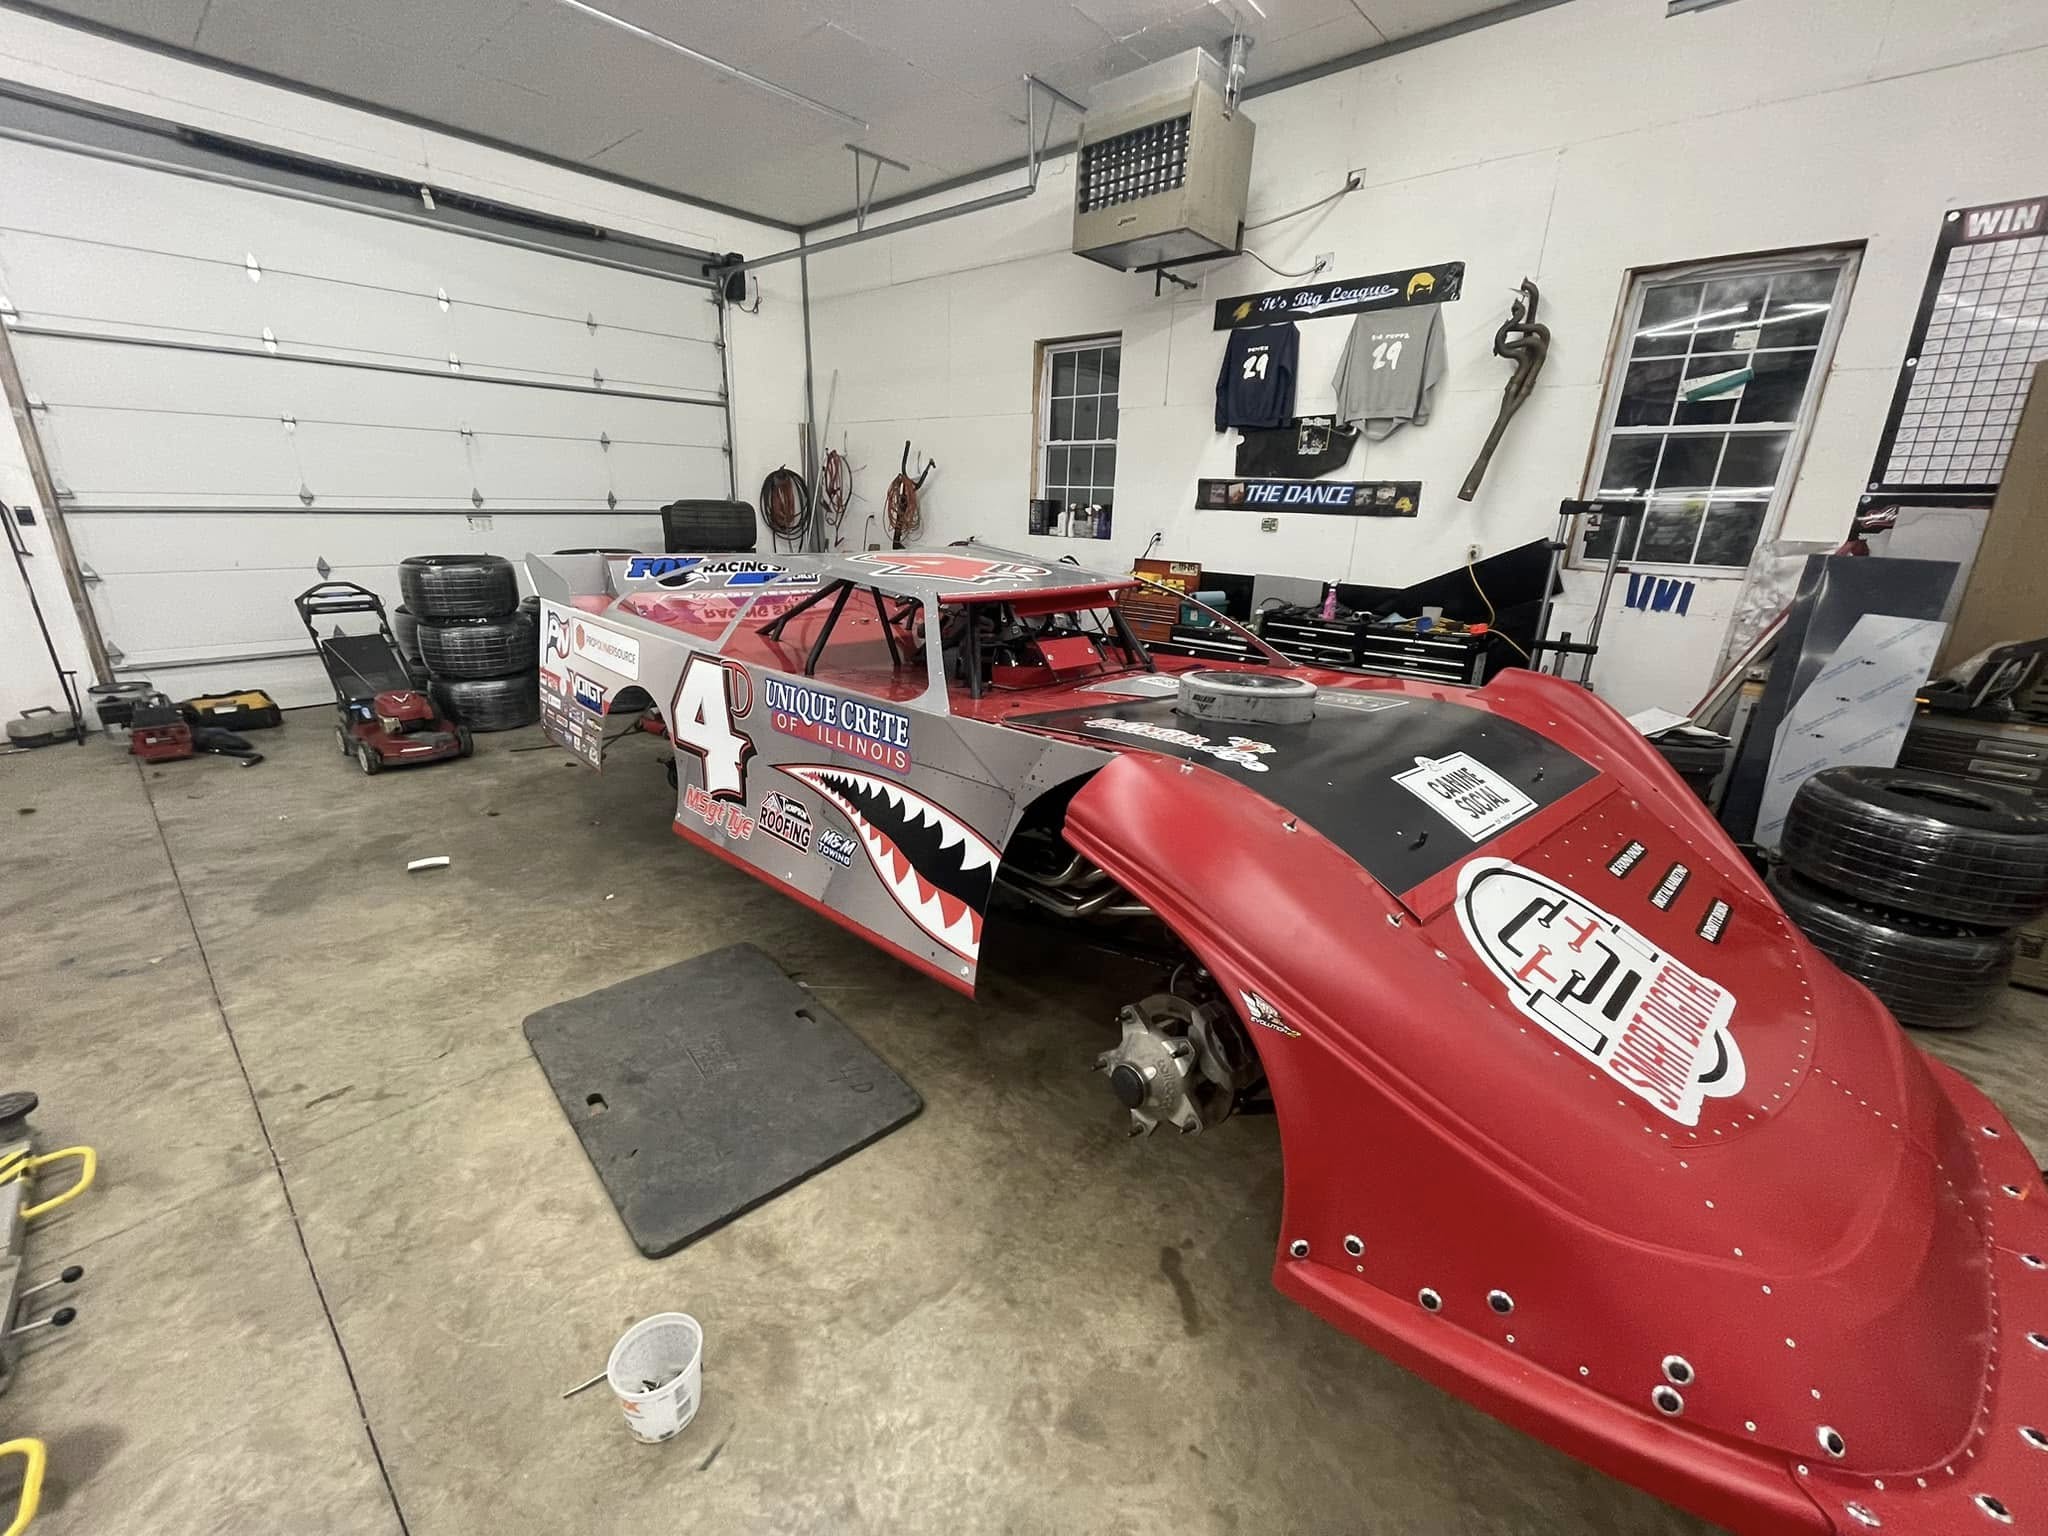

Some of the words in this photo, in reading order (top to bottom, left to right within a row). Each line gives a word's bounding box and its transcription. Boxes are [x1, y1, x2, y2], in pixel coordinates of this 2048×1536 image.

[1967, 204, 2040, 238] WIN
[1259, 297, 1287, 312] It's
[1292, 291, 1323, 307] Big
[1325, 284, 1391, 302] League
[1243, 353, 1269, 380] 29
[1373, 341, 1402, 370] 29
[1246, 485, 1284, 502] THE
[1283, 486, 1354, 504] DANCE
[703, 561, 769, 573] RACING
[568, 669, 605, 705] VOIGT
[765, 680, 836, 726] UNIQUE
[840, 700, 909, 747] CRETE
[777, 713, 802, 732] OF
[818, 725, 907, 769] ILLINOIS
[1427, 767, 1486, 800] CANINE
[686, 785, 725, 825] MSgt
[726, 804, 755, 840] Tye
[1455, 786, 1510, 819] SOCIAL
[760, 806, 810, 847] ROOFING
[820, 830, 857, 856] M&M
[817, 841, 850, 866] TOWING
[1640, 961, 1721, 1048] DIGITAL
[1609, 1013, 1694, 1110] SMART
